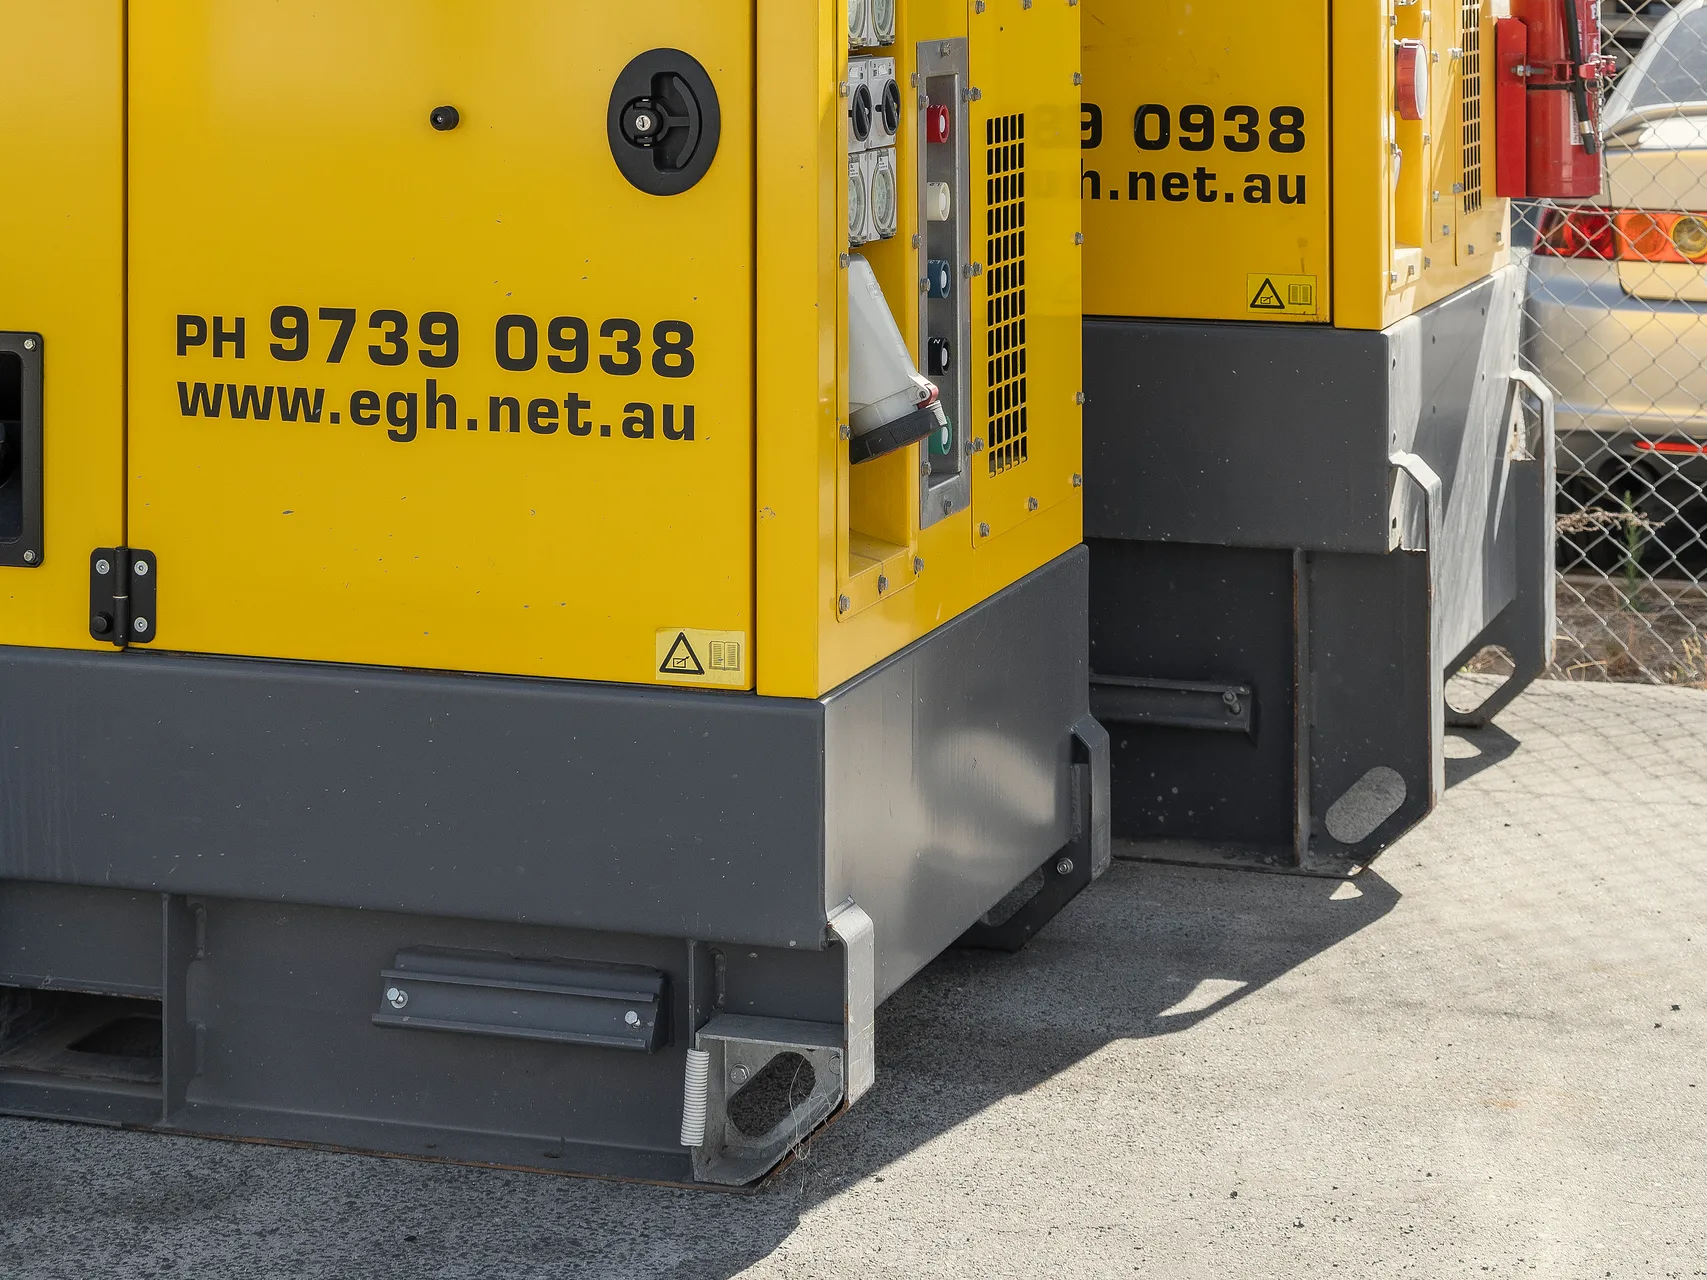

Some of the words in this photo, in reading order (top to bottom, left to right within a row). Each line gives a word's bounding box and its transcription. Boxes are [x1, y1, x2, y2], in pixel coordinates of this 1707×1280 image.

[1133, 103, 1306, 154] 0938
[176, 314, 246, 359] PH
[269, 305, 459, 369] 9739
[495, 314, 695, 379] 0938
[176, 378, 695, 443] www.egh.net.au
